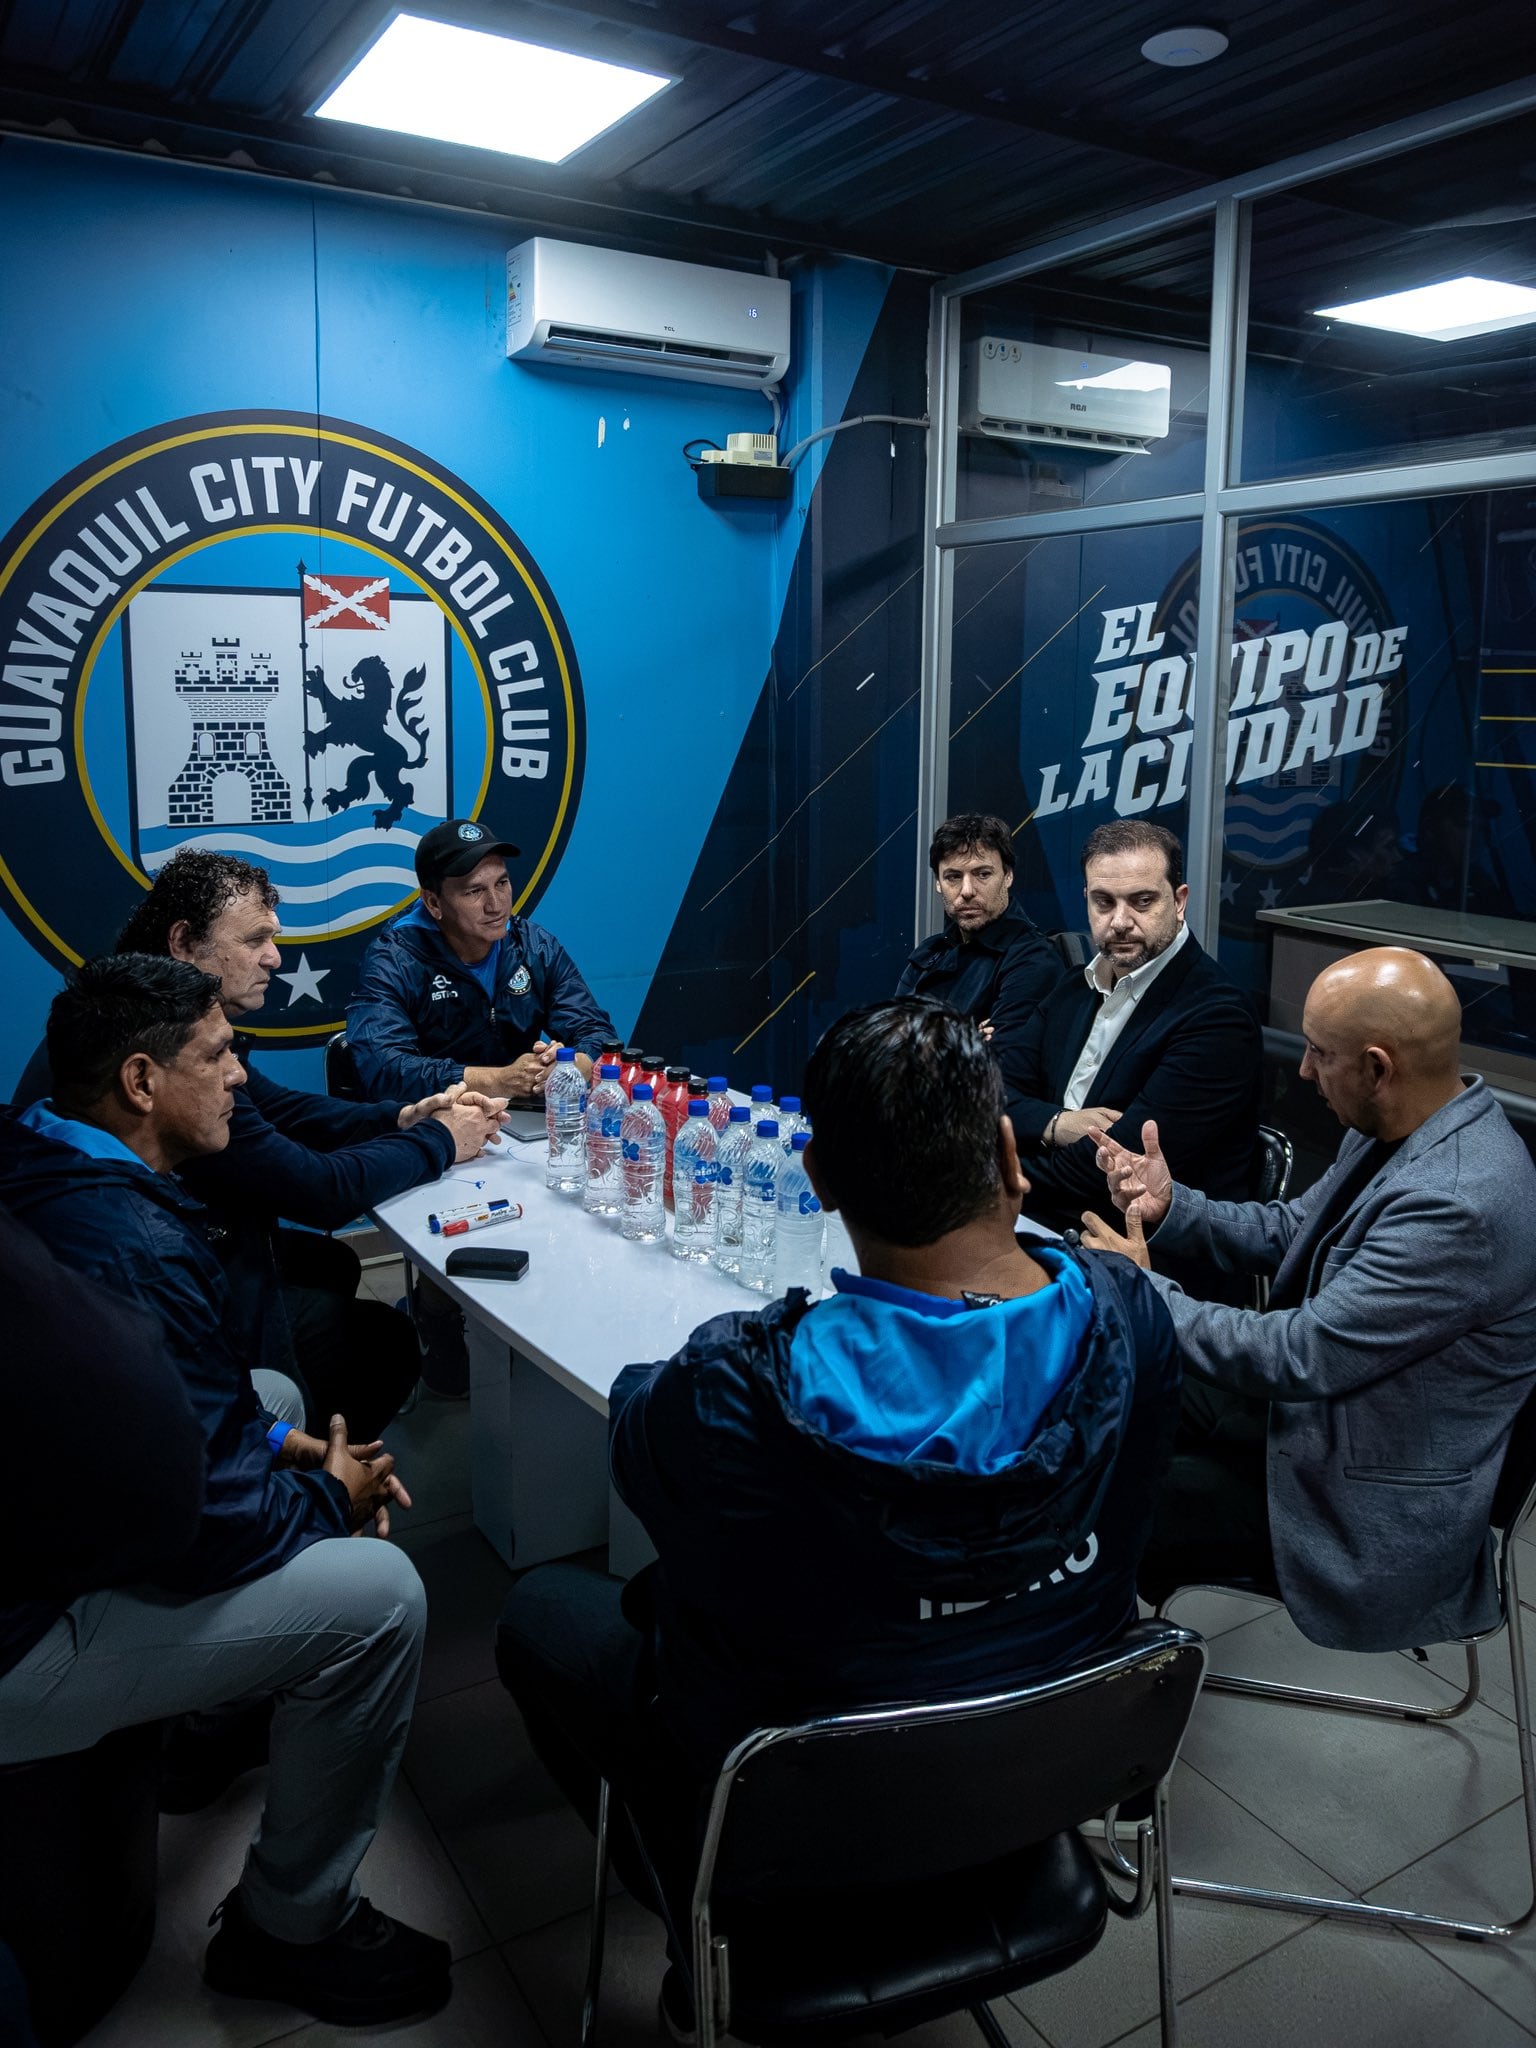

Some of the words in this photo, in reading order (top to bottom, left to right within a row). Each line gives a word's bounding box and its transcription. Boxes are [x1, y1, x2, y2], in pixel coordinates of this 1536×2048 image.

[748, 308, 758, 318] 16
[1070, 403, 1087, 411] RCA
[0, 487, 190, 787] GUAYAQUIL
[190, 456, 323, 524] CITY
[337, 469, 513, 639] FUTBOL
[489, 640, 550, 780] CLUB
[1094, 602, 1165, 664] EL
[1347, 625, 1408, 682] DE
[1033, 750, 1112, 819] LA
